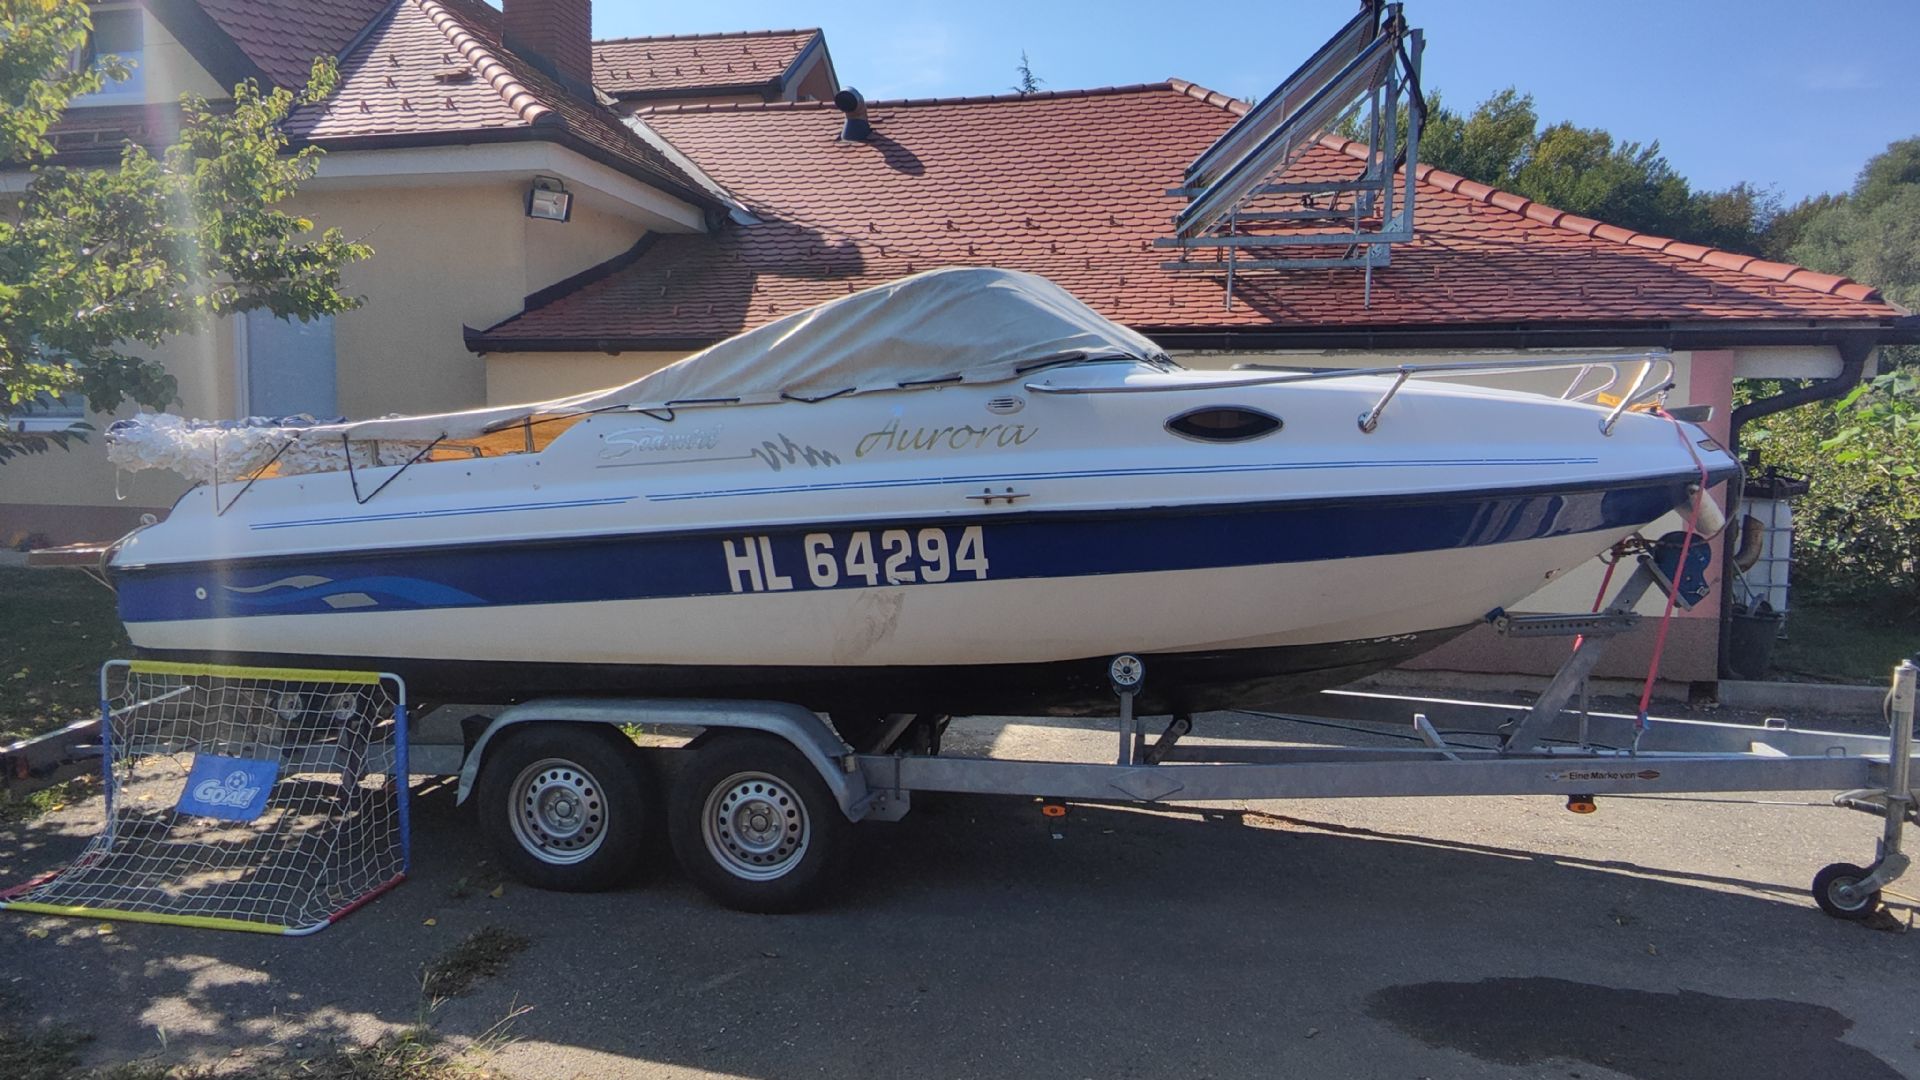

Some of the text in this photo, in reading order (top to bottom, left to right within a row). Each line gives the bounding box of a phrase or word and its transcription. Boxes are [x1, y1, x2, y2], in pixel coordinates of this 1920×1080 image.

[855, 417, 1040, 458] Aurora
[722, 525, 989, 593] HL 64294
[1569, 771, 1636, 780] Eine Marke von
